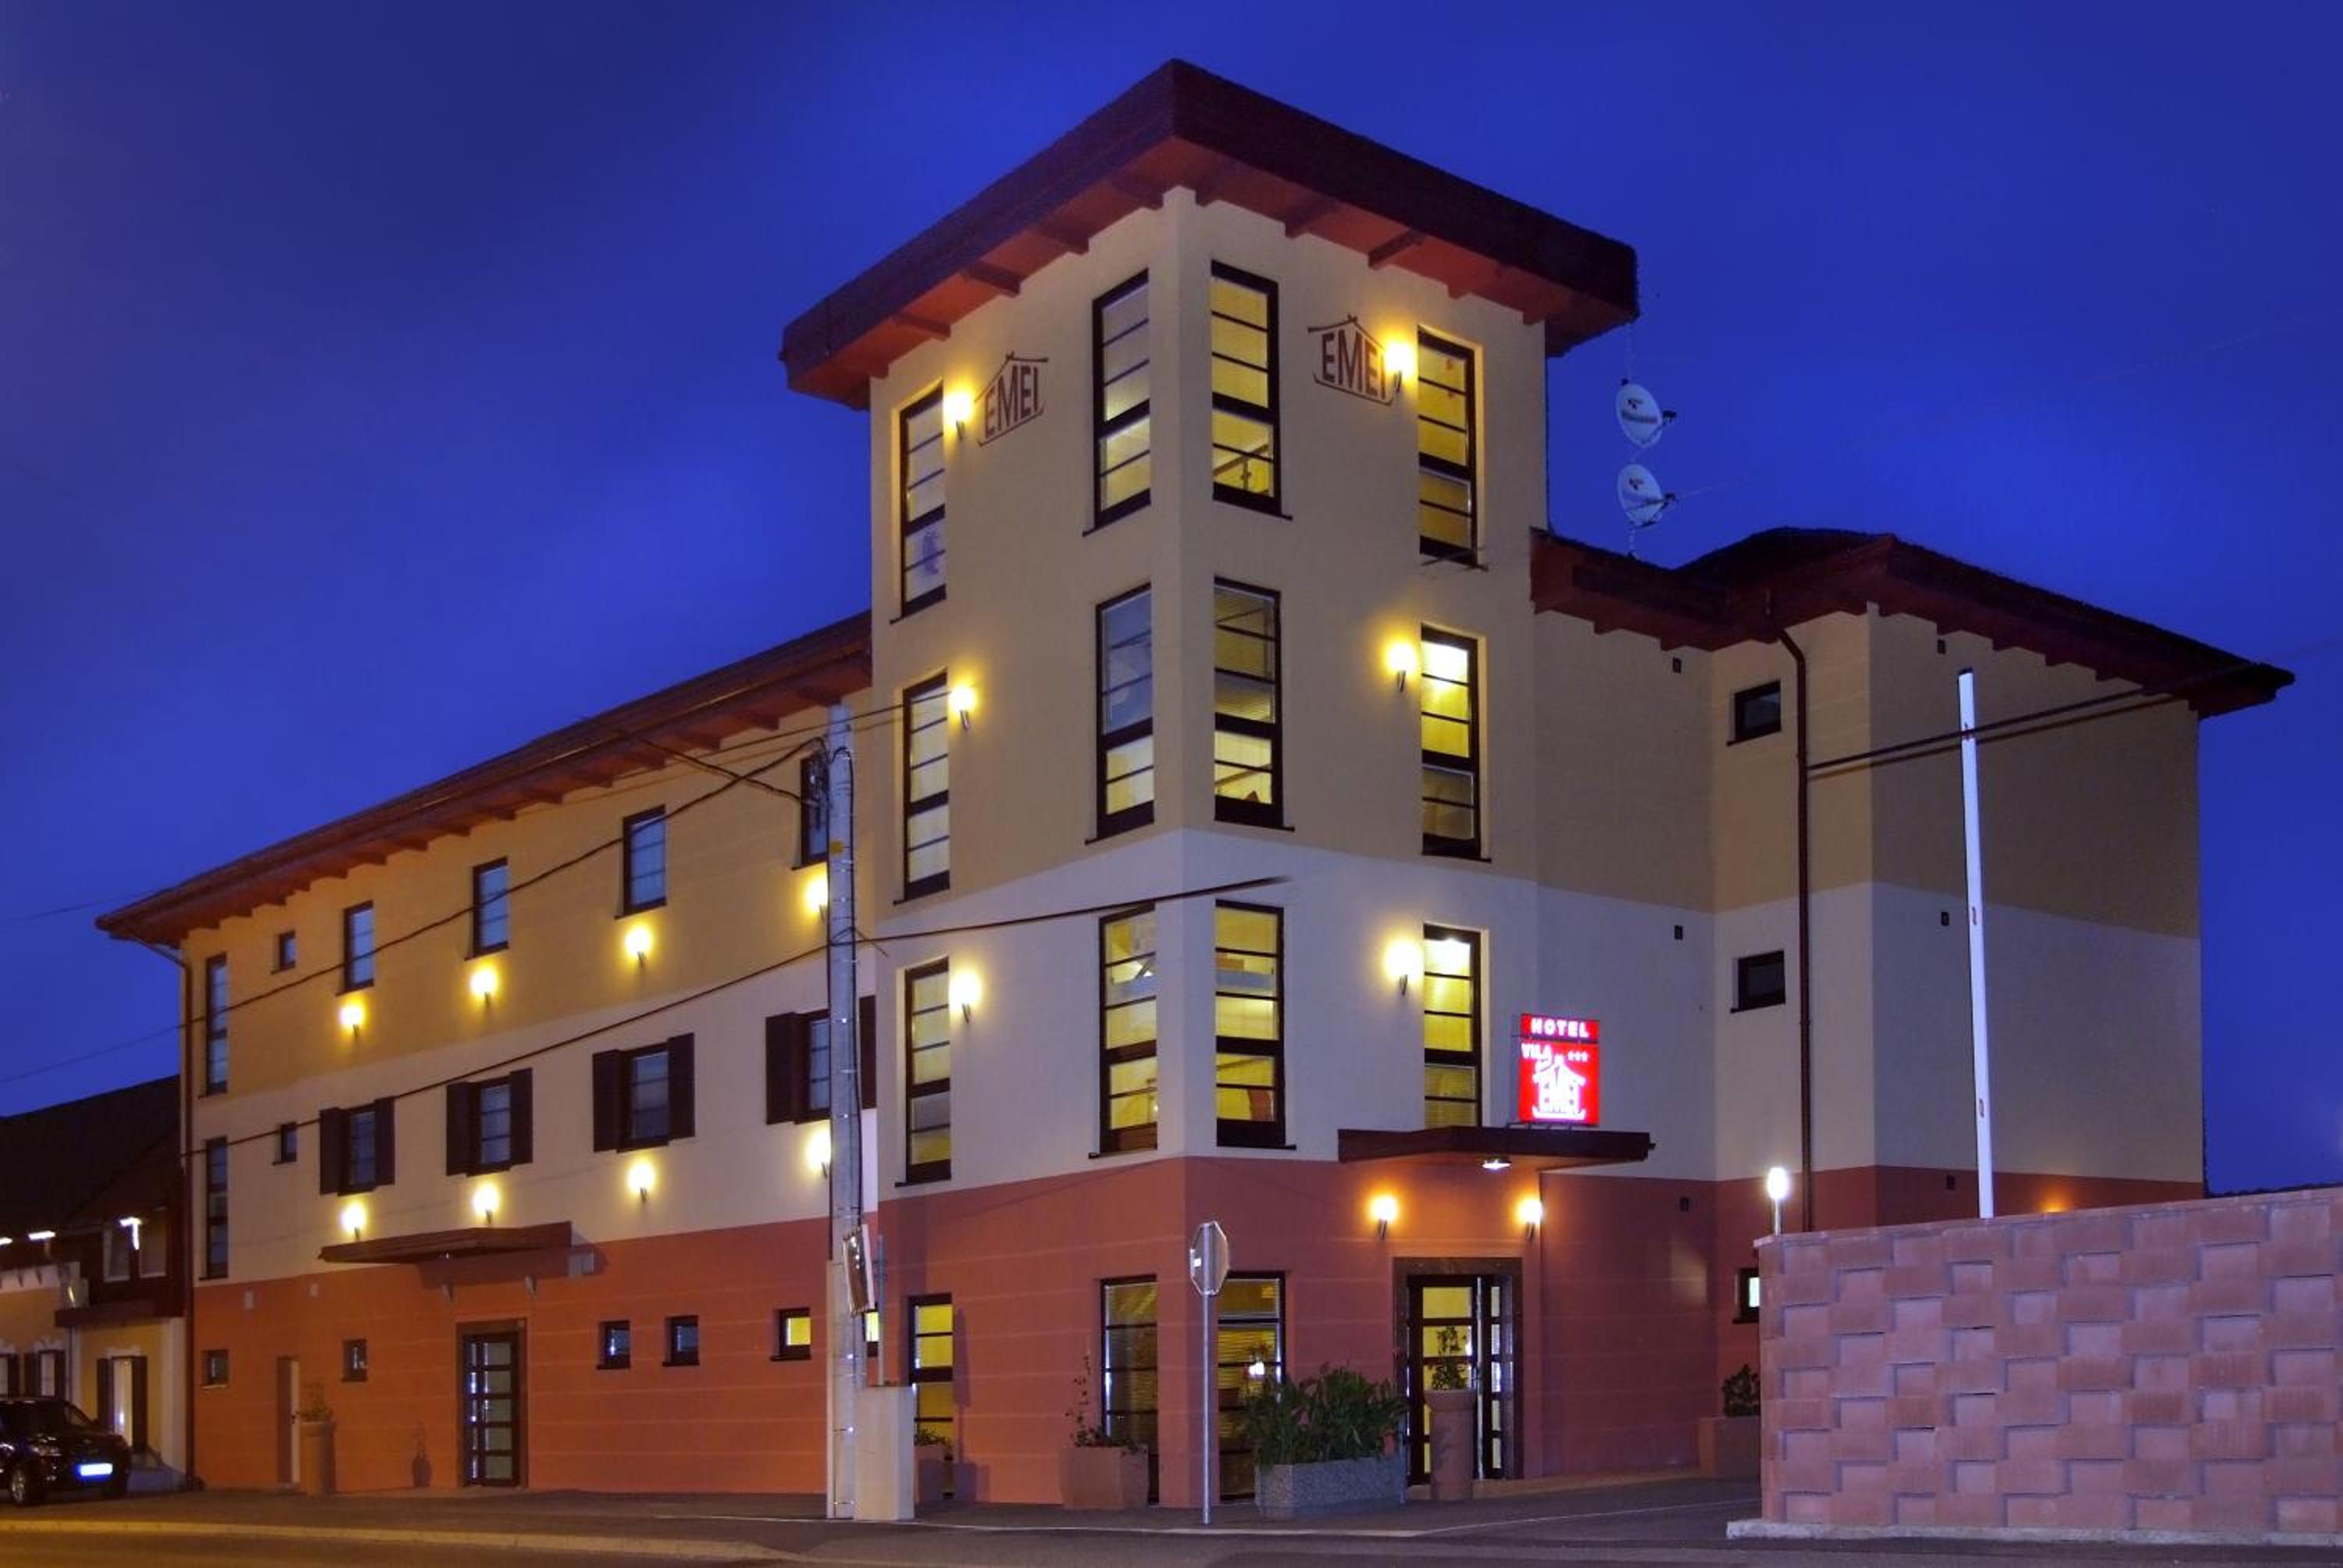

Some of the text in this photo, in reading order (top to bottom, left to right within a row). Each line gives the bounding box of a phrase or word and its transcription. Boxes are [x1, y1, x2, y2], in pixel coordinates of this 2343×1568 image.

[1322, 329, 1385, 400] EMEI
[985, 365, 1038, 439] EMEI
[1531, 1017, 1589, 1037] HOTEL
